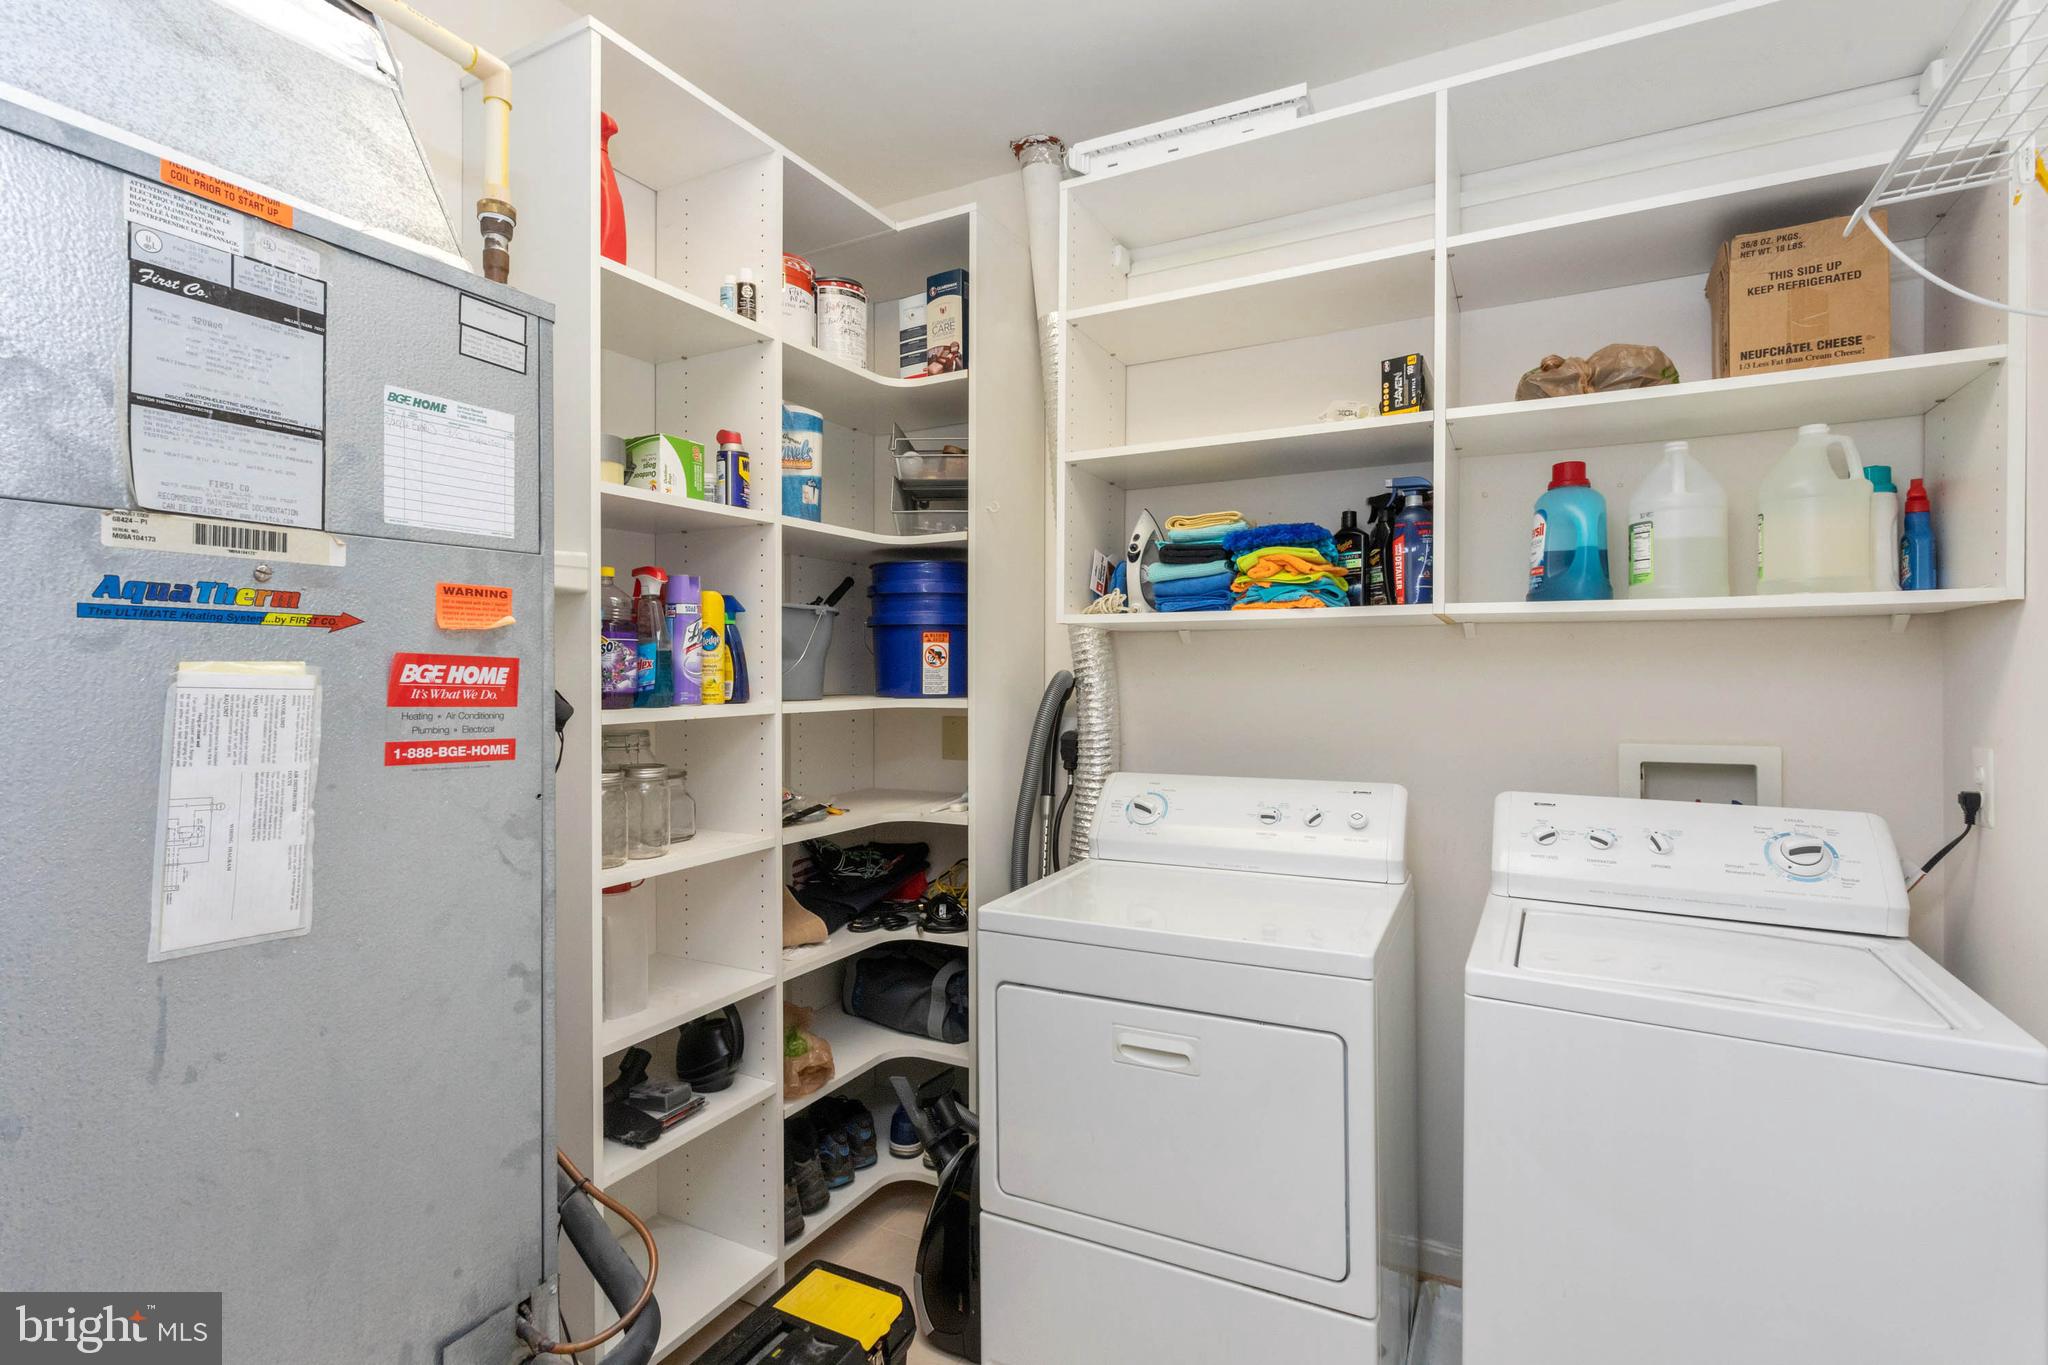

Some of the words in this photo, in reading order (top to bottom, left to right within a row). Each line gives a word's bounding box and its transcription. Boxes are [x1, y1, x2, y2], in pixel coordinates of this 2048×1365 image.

[170, 169, 191, 185] COIL
[194, 178, 221, 196] PRIOR
[224, 189, 236, 202] TO
[238, 195, 264, 213] START
[267, 207, 279, 217] UP
[1740, 239, 1758, 250] 36/8
[1760, 237, 1774, 247] OZ.
[1776, 232, 1802, 243] PKGS.
[1740, 248, 1756, 259] NET
[1758, 246, 1773, 256] WT.
[1776, 244, 1785, 253] 18
[1787, 241, 1806, 252] LBS.
[1768, 270, 1794, 282] THIS
[1797, 263, 1823, 277] SIDE
[1826, 260, 1843, 271] UP
[138, 267, 181, 291] First
[183, 282, 209, 299] Co.
[1747, 284, 1774, 297] KEEP
[1777, 269, 1862, 292] REFRIGERATED
[931, 321, 956, 335] CARE
[1816, 335, 1863, 351] CHEESE
[1739, 362, 1751, 371] 1/3
[1752, 359, 1769, 369] Less
[1771, 357, 1784, 367] Fat
[1785, 355, 1803, 365] than
[1805, 352, 1832, 363] Cream
[1834, 347, 1865, 359] Cheese!
[1394, 371, 1403, 408] RAVEN
[164, 393, 203, 406] DISCONNECT
[204, 401, 224, 410] POWER
[240, 402, 259, 412] SHOCK
[259, 406, 282, 416] HAZARD
[387, 391, 412, 406] BGE
[412, 397, 448, 414] HOME
[643, 461, 657, 471] Bags
[157, 491, 203, 505] RECOMMENDED
[442, 586, 508, 600] WARNING
[88, 606, 112, 617] The
[115, 607, 177, 620] ULTIMATE
[180, 610, 224, 622] Heating
[289, 615, 318, 626] FIRST
[321, 617, 339, 627] CO.
[399, 663, 447, 684] BGE
[447, 666, 510, 685] HOME
[410, 688, 429, 700] It's
[430, 689, 461, 700] What
[462, 689, 478, 700] We
[480, 690, 498, 701] Do.
[401, 711, 434, 722] Heating
[445, 711, 457, 721] Air
[458, 711, 505, 721] Conditioning
[411, 726, 450, 737] Plumbing
[461, 725, 495, 735] Electrical
[393, 744, 510, 760] 1-888-BGE-HOME
